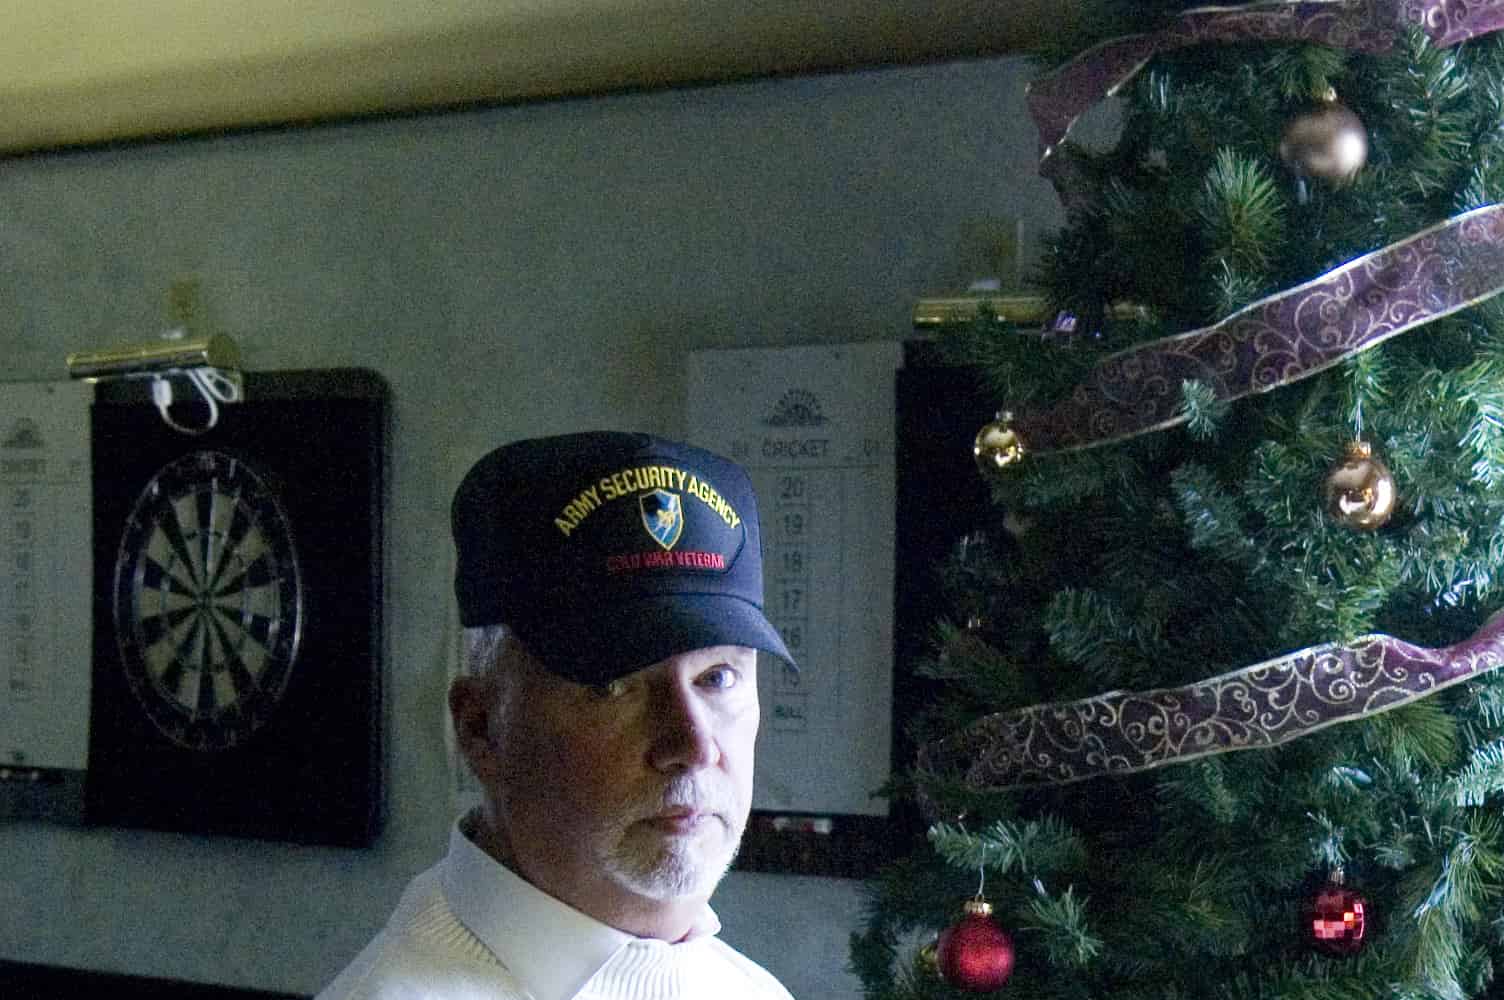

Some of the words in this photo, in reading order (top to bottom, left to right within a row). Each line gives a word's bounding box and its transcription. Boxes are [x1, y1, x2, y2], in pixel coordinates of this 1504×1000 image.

[761, 438, 829, 458] CRICKET
[780, 476, 804, 499] 20
[554, 485, 603, 538] ARMY
[600, 466, 688, 501] SECURITY
[687, 475, 742, 530] AGENCY
[784, 514, 804, 535] 19
[642, 551, 673, 568] WAR
[675, 551, 725, 569] VETERAN
[783, 551, 803, 573] 18
[783, 588, 803, 610] 17
